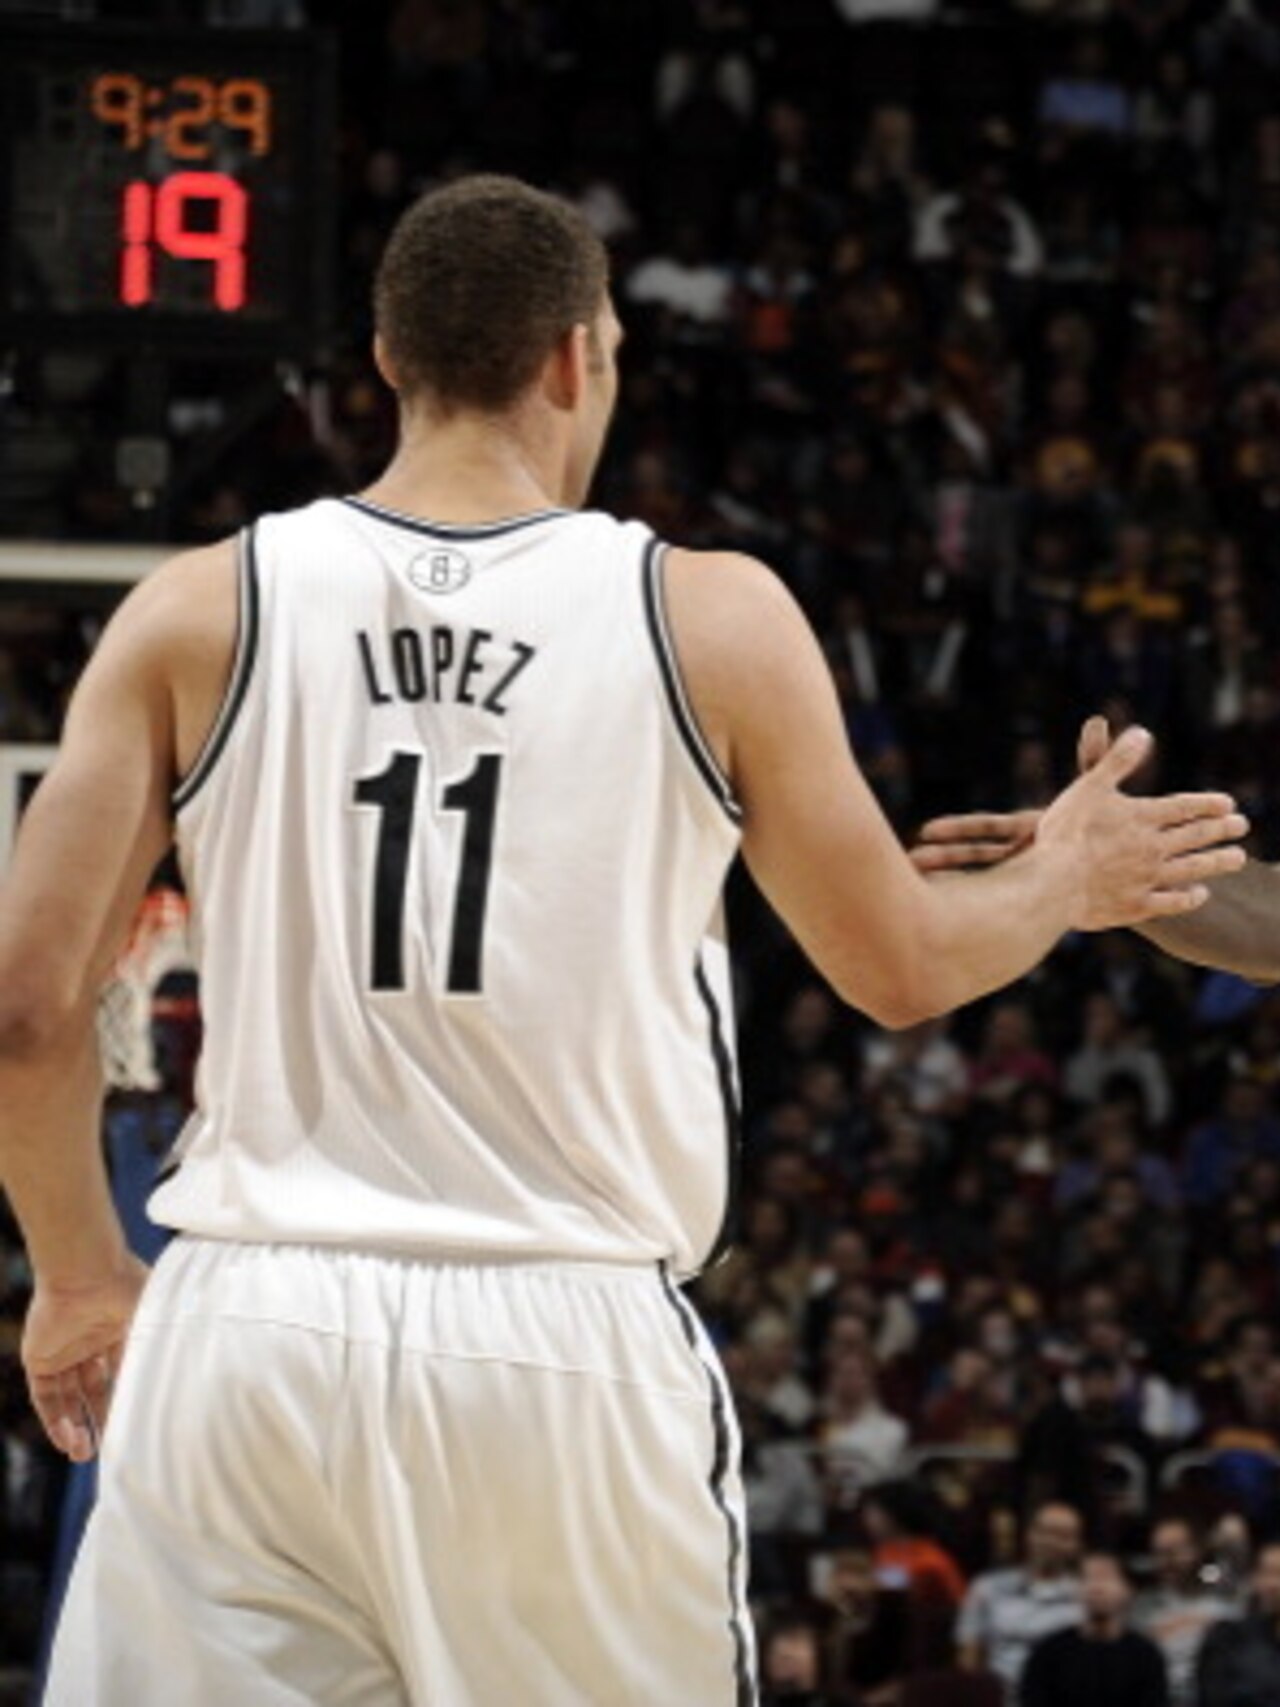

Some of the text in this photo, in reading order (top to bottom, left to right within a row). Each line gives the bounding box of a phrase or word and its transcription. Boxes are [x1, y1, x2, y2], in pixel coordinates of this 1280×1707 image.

[91, 72, 271, 159] 9:29
[120, 171, 248, 311] 19
[356, 622, 538, 716] LOPEZ
[352, 750, 505, 993] 11
